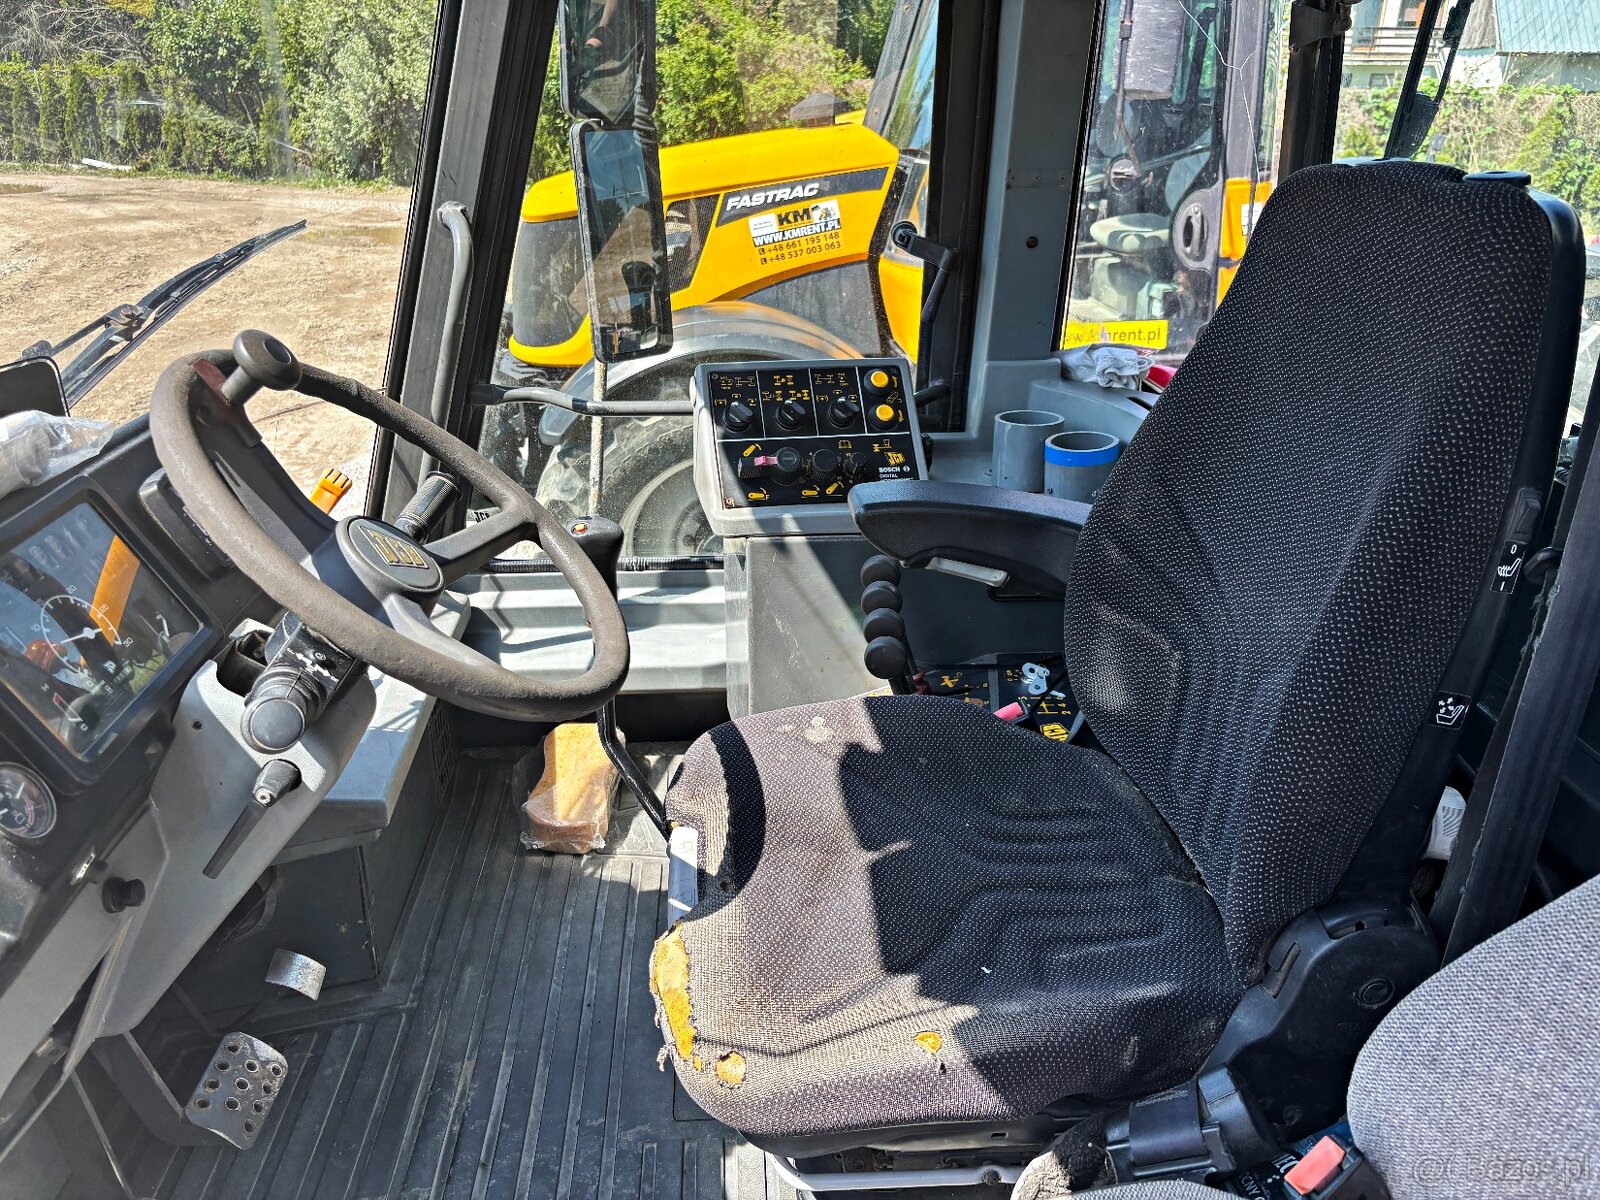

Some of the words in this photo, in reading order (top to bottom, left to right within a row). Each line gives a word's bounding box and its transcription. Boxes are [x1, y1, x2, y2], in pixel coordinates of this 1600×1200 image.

[725, 182, 820, 212] FASTRAC
[777, 206, 813, 227] KM
[753, 219, 842, 246] WWW.KMRENT.PL
[767, 243, 784, 254] +48
[786, 239, 802, 250] 661
[805, 236, 822, 246] 195
[824, 232, 840, 242] 148
[769, 252, 786, 264] +48
[788, 249, 804, 260] 537
[806, 245, 823, 256] 003
[825, 241, 841, 251] 063
[367, 528, 425, 566] JCB
[123, 636, 134, 648] 30
